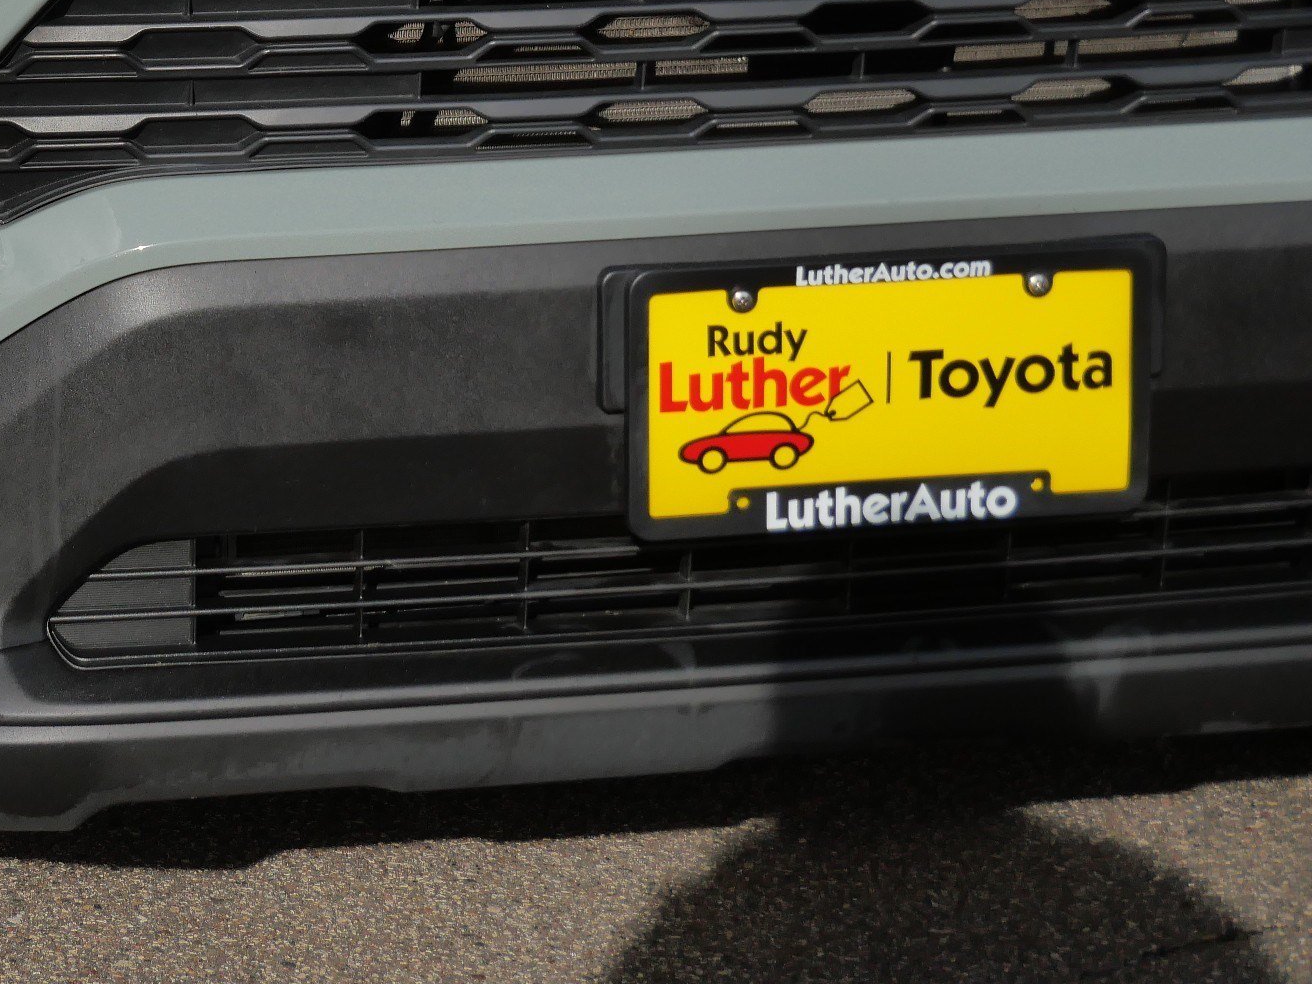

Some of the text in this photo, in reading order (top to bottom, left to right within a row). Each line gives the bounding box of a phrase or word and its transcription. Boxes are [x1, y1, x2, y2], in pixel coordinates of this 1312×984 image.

[796, 259, 991, 287] LutherAuto.com
[707, 321, 808, 361] Rudy
[659, 342, 1112, 413] Luther Toyota
[766, 483, 1017, 532] LutherAuto
